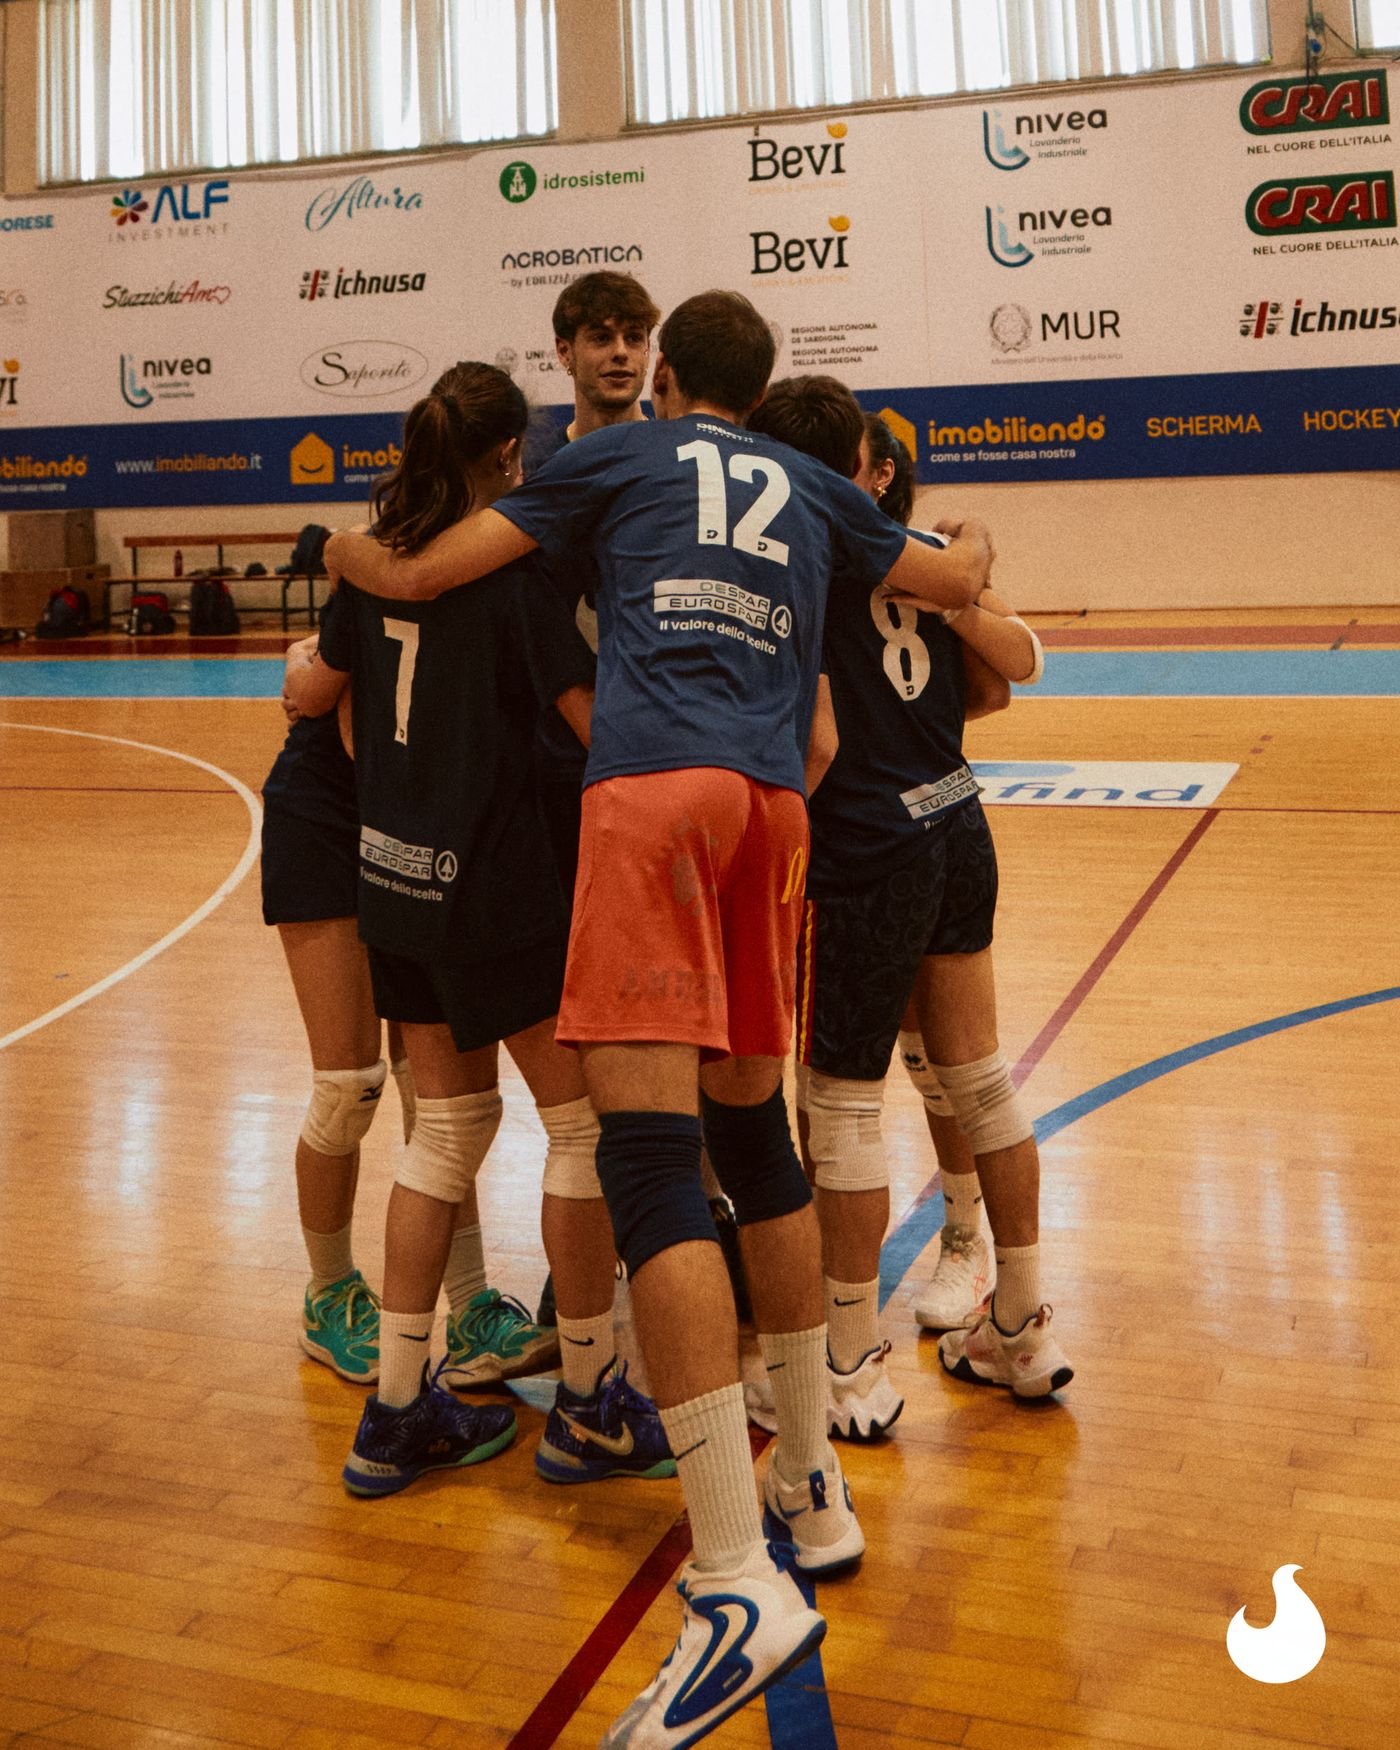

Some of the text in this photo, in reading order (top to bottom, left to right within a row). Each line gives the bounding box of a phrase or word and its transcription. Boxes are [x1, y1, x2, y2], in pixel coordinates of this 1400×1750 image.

[1249, 78, 1382, 128] CRAI
[1016, 109, 1107, 135] nivea
[747, 122, 848, 181] Bevi
[1029, 136, 1081, 147] Lavanderia
[1247, 134, 1392, 155] NEL CUORE DELL'ITALIA
[543, 166, 645, 190] idrosistemi
[151, 181, 229, 223] ALF
[1255, 179, 1389, 229] CRAI
[0, 214, 54, 232] ORESE
[1019, 206, 1112, 231] nivea
[108, 223, 229, 242] INVESTMENT
[750, 214, 849, 275] Bevi
[1033, 233, 1085, 245] Lavanderia
[501, 245, 643, 269] ACROBATICA
[1253, 236, 1399, 256] NEL CUORE DELL'ITALIA
[334, 267, 426, 299] ichnusa
[791, 325, 826, 334] REGIONE
[1041, 310, 1120, 341] MUR
[1290, 298, 1400, 336] ichnus
[143, 357, 212, 378] nivea
[928, 414, 1106, 446] imobiliando
[1146, 413, 1262, 438] SCHERMA
[1303, 408, 1400, 431] HOCKEY
[114, 452, 263, 474] www.imobiliando.it
[930, 448, 1076, 463] come se fosse casa nostra
[676, 439, 791, 567] 12
[700, 581, 770, 611] DESPAR
[669, 597, 767, 627] EUROSPAR
[671, 618, 715, 631] valore
[716, 624, 745, 641] della
[870, 584, 931, 702] 8
[383, 616, 420, 746] 7
[919, 780, 978, 813] EUROSPAR
[996, 781, 1205, 801] find
[412, 888, 443, 902] scelta
